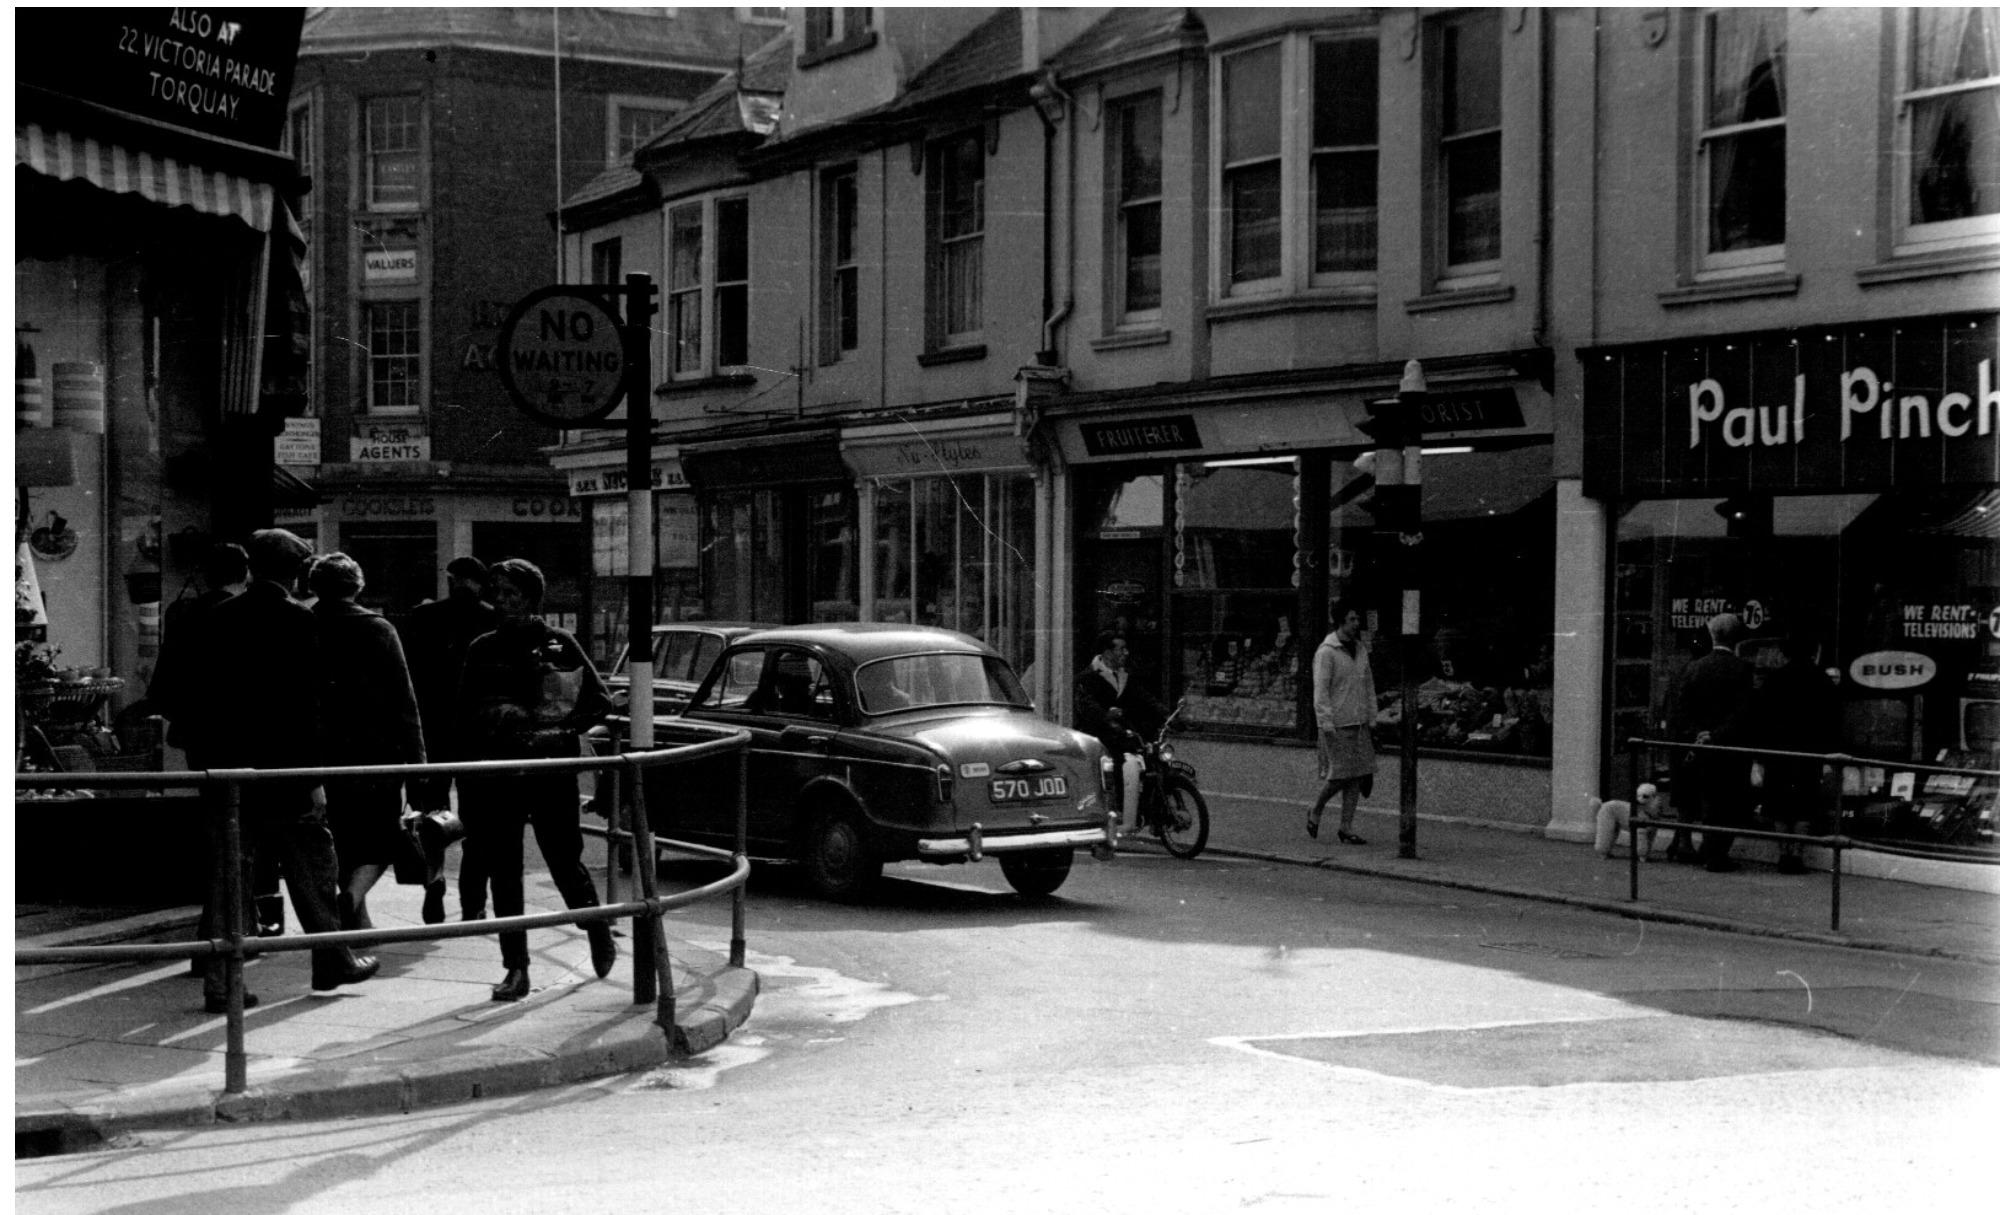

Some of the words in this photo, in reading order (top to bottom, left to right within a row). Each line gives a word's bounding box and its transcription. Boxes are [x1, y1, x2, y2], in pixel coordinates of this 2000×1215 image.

[169, 7, 212, 38] ALSO
[216, 20, 242, 46] AT
[143, 32, 221, 80] VICTORIA
[224, 58, 276, 96] PARADE
[149, 71, 240, 120] TORQUAY
[367, 257, 414, 270] VALUERS
[540, 309, 594, 342] NO
[513, 349, 620, 374] WAITING
[1421, 400, 1485, 424] ORIST
[1689, 373, 1806, 450] Paul
[1096, 424, 1183, 448] FRUITERER
[359, 446, 421, 459] AGENTS
[1671, 599, 1689, 614] WE
[1903, 604, 1926, 621] WE
[1902, 621, 1977, 639] TELEVISIONS
[1862, 664, 1925, 676] BUSH
[992, 779, 1030, 800] 570
[1034, 776, 1067, 796] JOD
